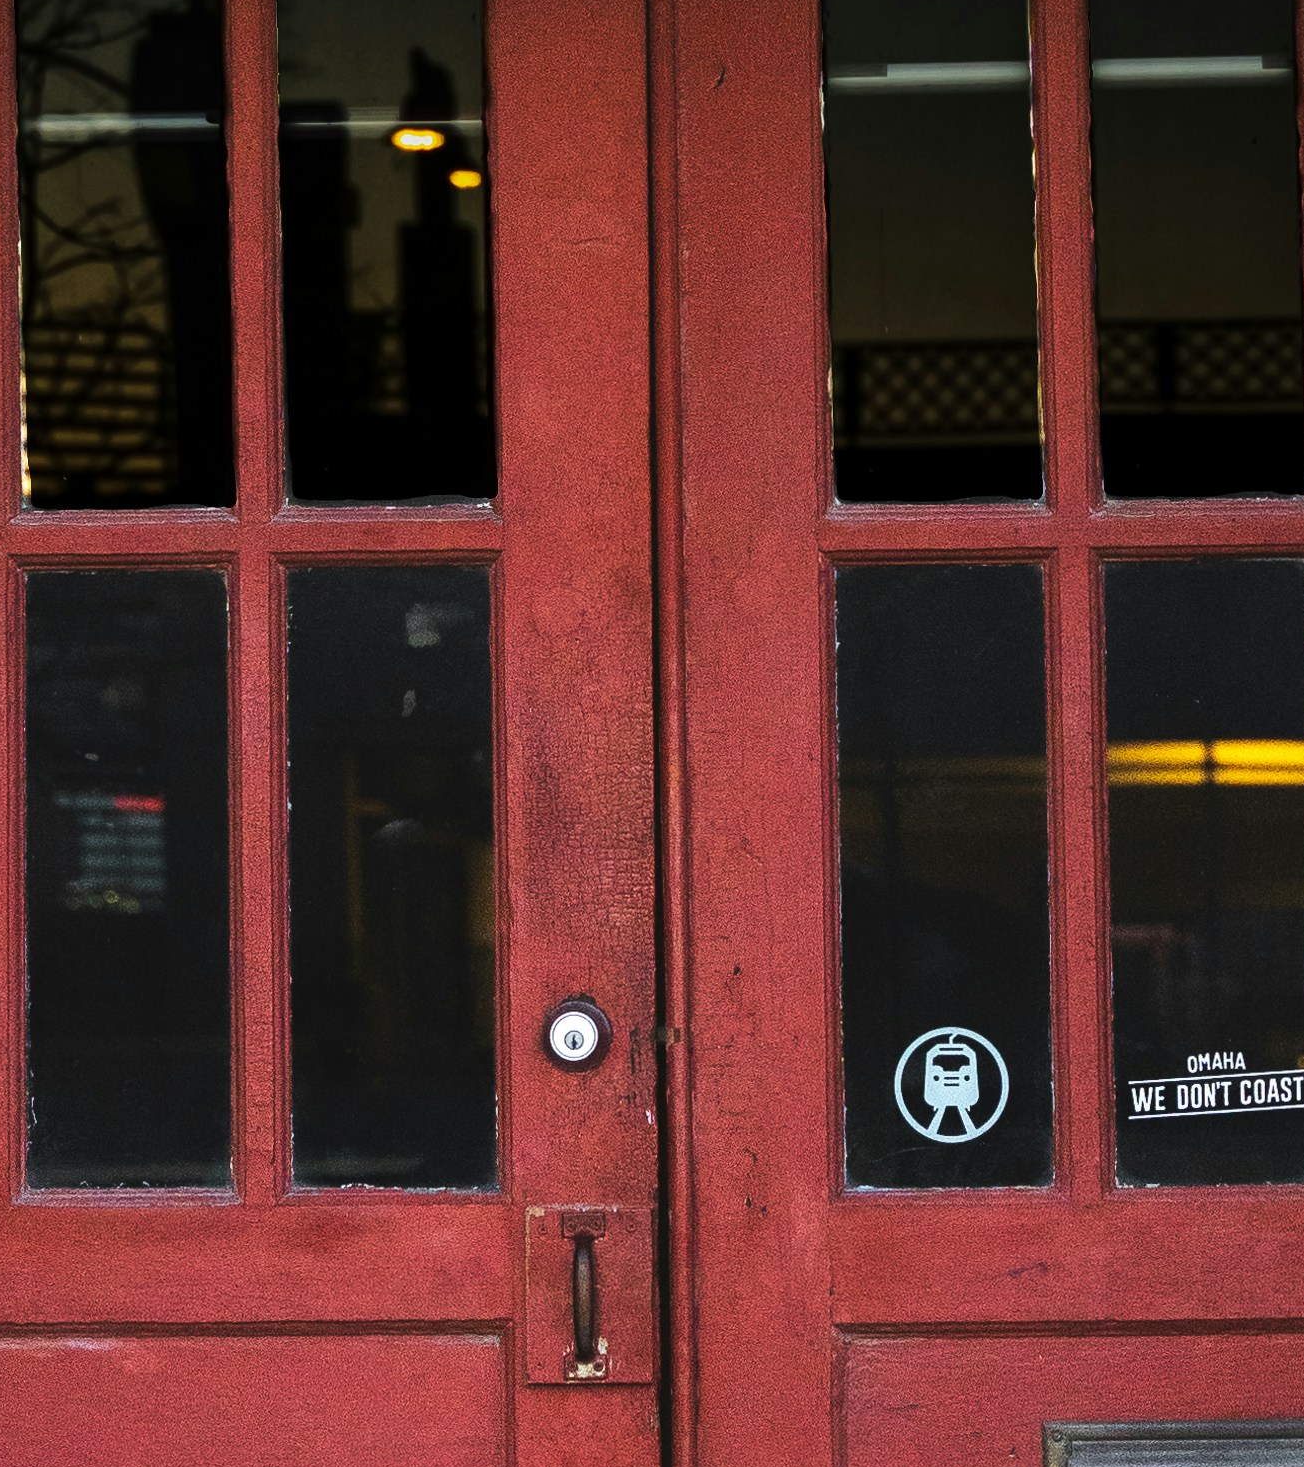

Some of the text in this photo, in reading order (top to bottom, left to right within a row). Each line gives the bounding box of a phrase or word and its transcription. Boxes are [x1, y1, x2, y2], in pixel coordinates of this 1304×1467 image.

[1187, 1051, 1246, 1074] OMAHA
[1131, 1076, 1304, 1113] WE DON'T COAST
